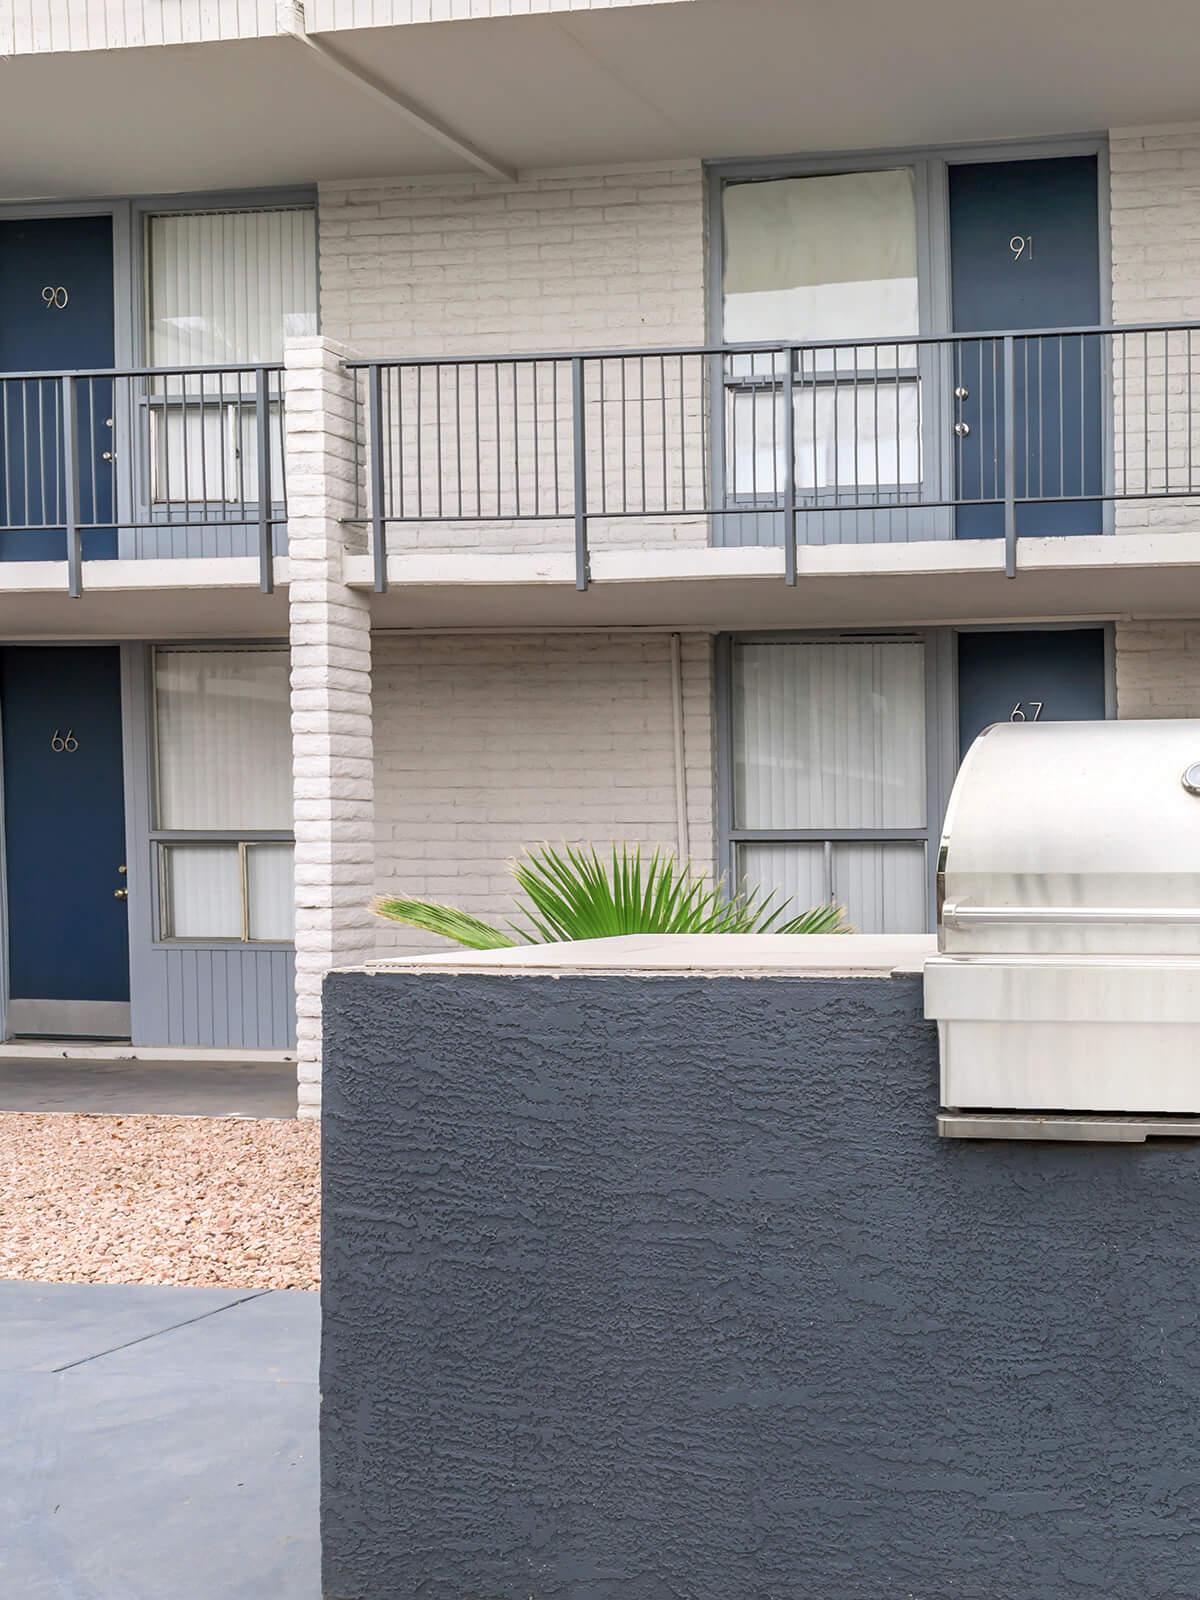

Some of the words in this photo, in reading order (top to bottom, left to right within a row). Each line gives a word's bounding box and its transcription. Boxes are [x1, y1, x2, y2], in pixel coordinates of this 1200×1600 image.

[1009, 235, 1033, 261] 91
[42, 286, 69, 309] 90
[1010, 702, 1044, 721] 67
[51, 730, 79, 753] 66
